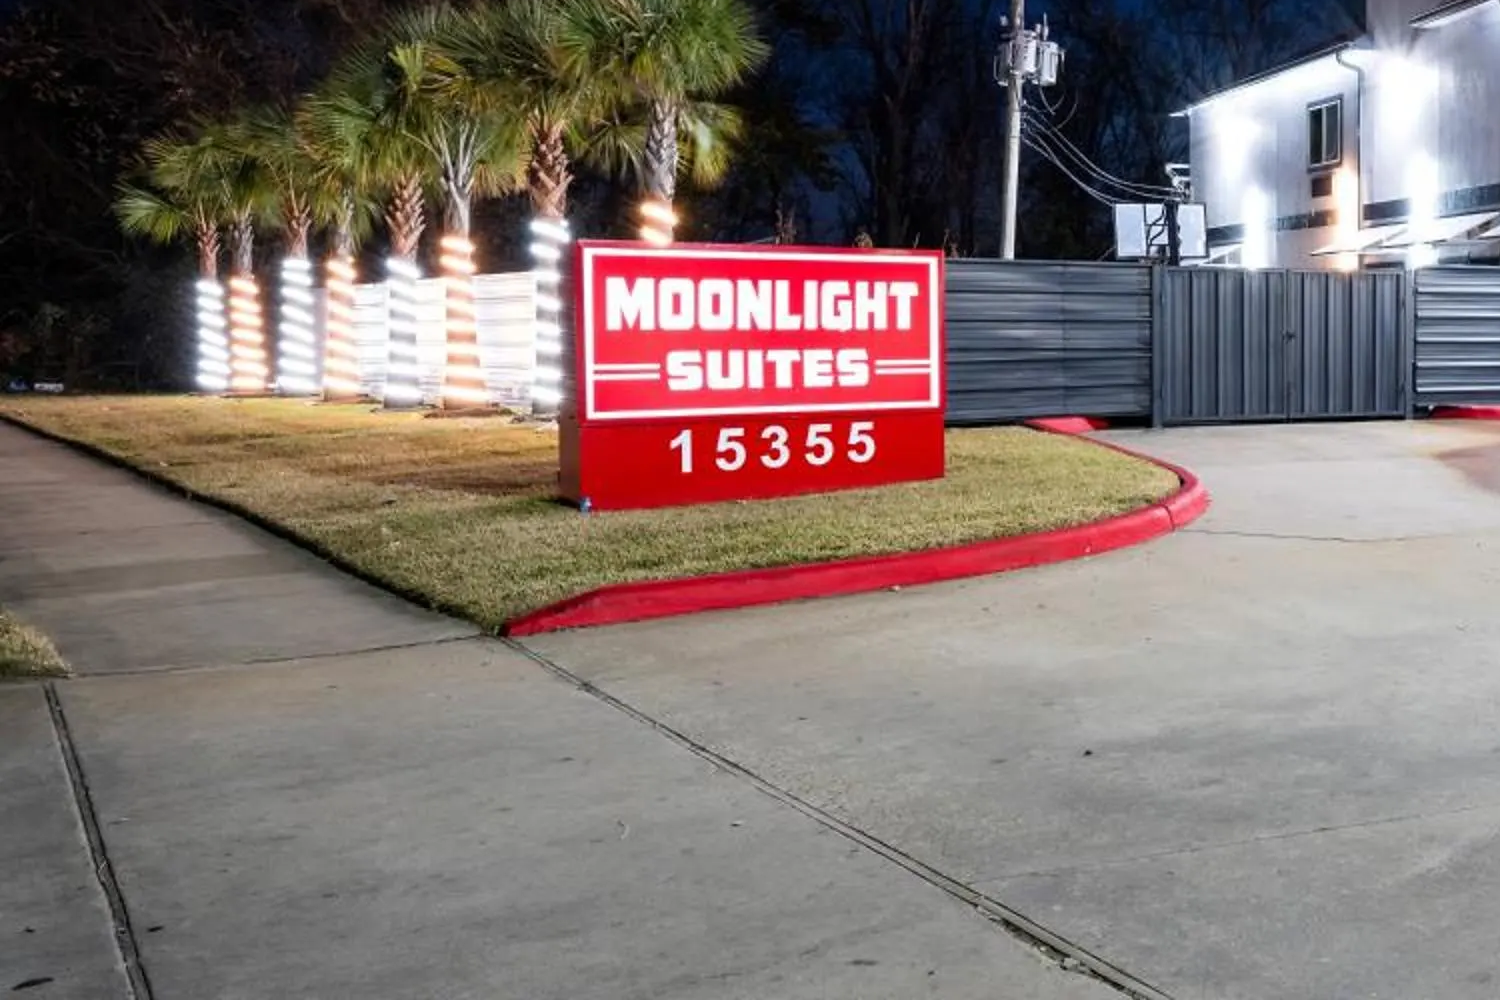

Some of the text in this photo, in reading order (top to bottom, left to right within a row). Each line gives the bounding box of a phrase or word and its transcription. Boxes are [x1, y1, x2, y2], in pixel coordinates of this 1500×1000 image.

[605, 276, 919, 332] MOONLIGHT
[667, 349, 870, 391] SUITES
[669, 421, 876, 473] 15355
